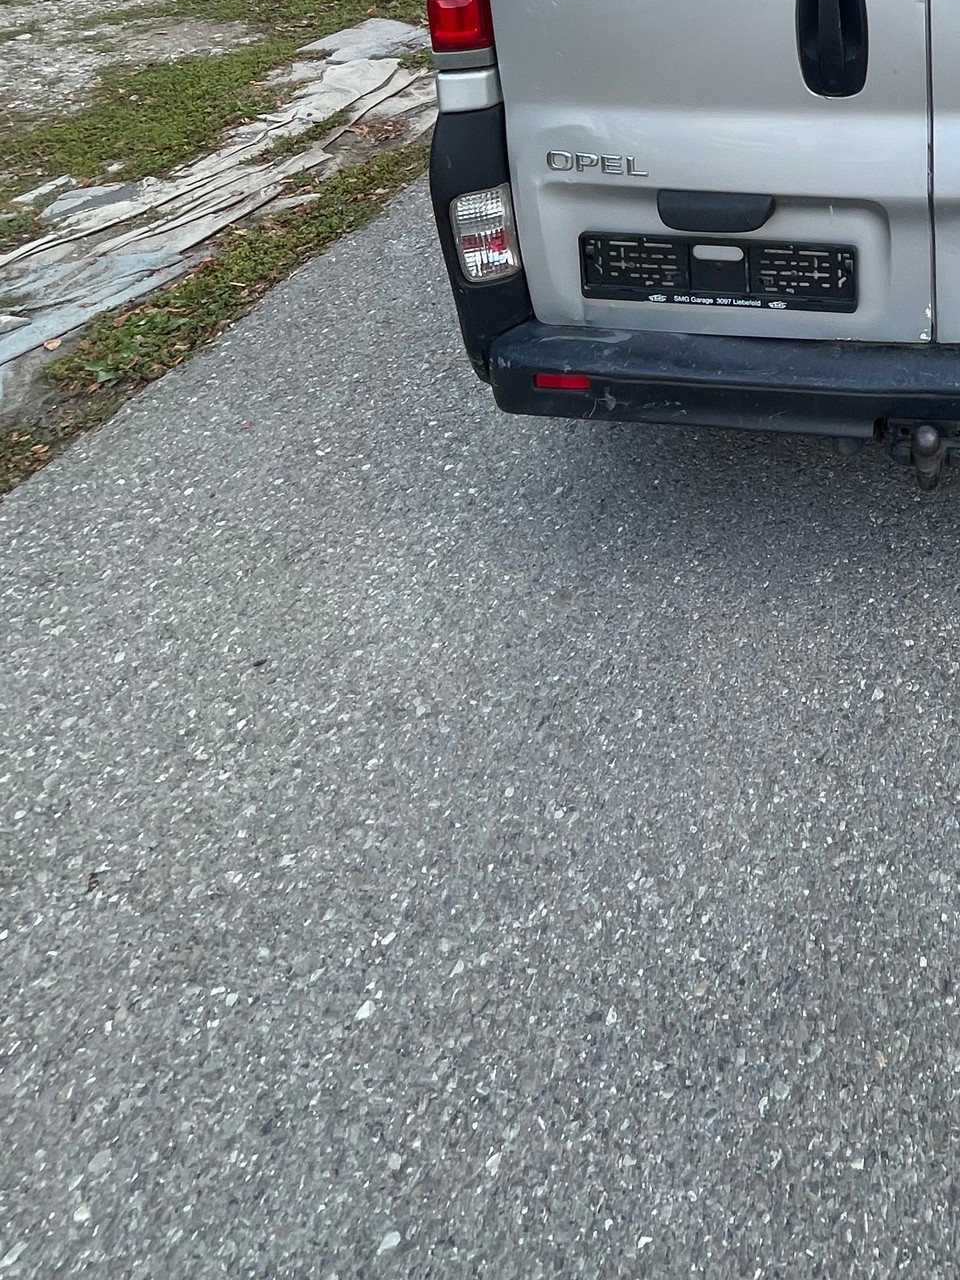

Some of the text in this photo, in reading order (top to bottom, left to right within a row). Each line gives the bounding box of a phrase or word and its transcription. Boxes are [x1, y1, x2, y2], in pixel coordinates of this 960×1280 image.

[546, 149, 649, 177] OPEL
[673, 295, 690, 303] SMG
[690, 296, 714, 305] Garage
